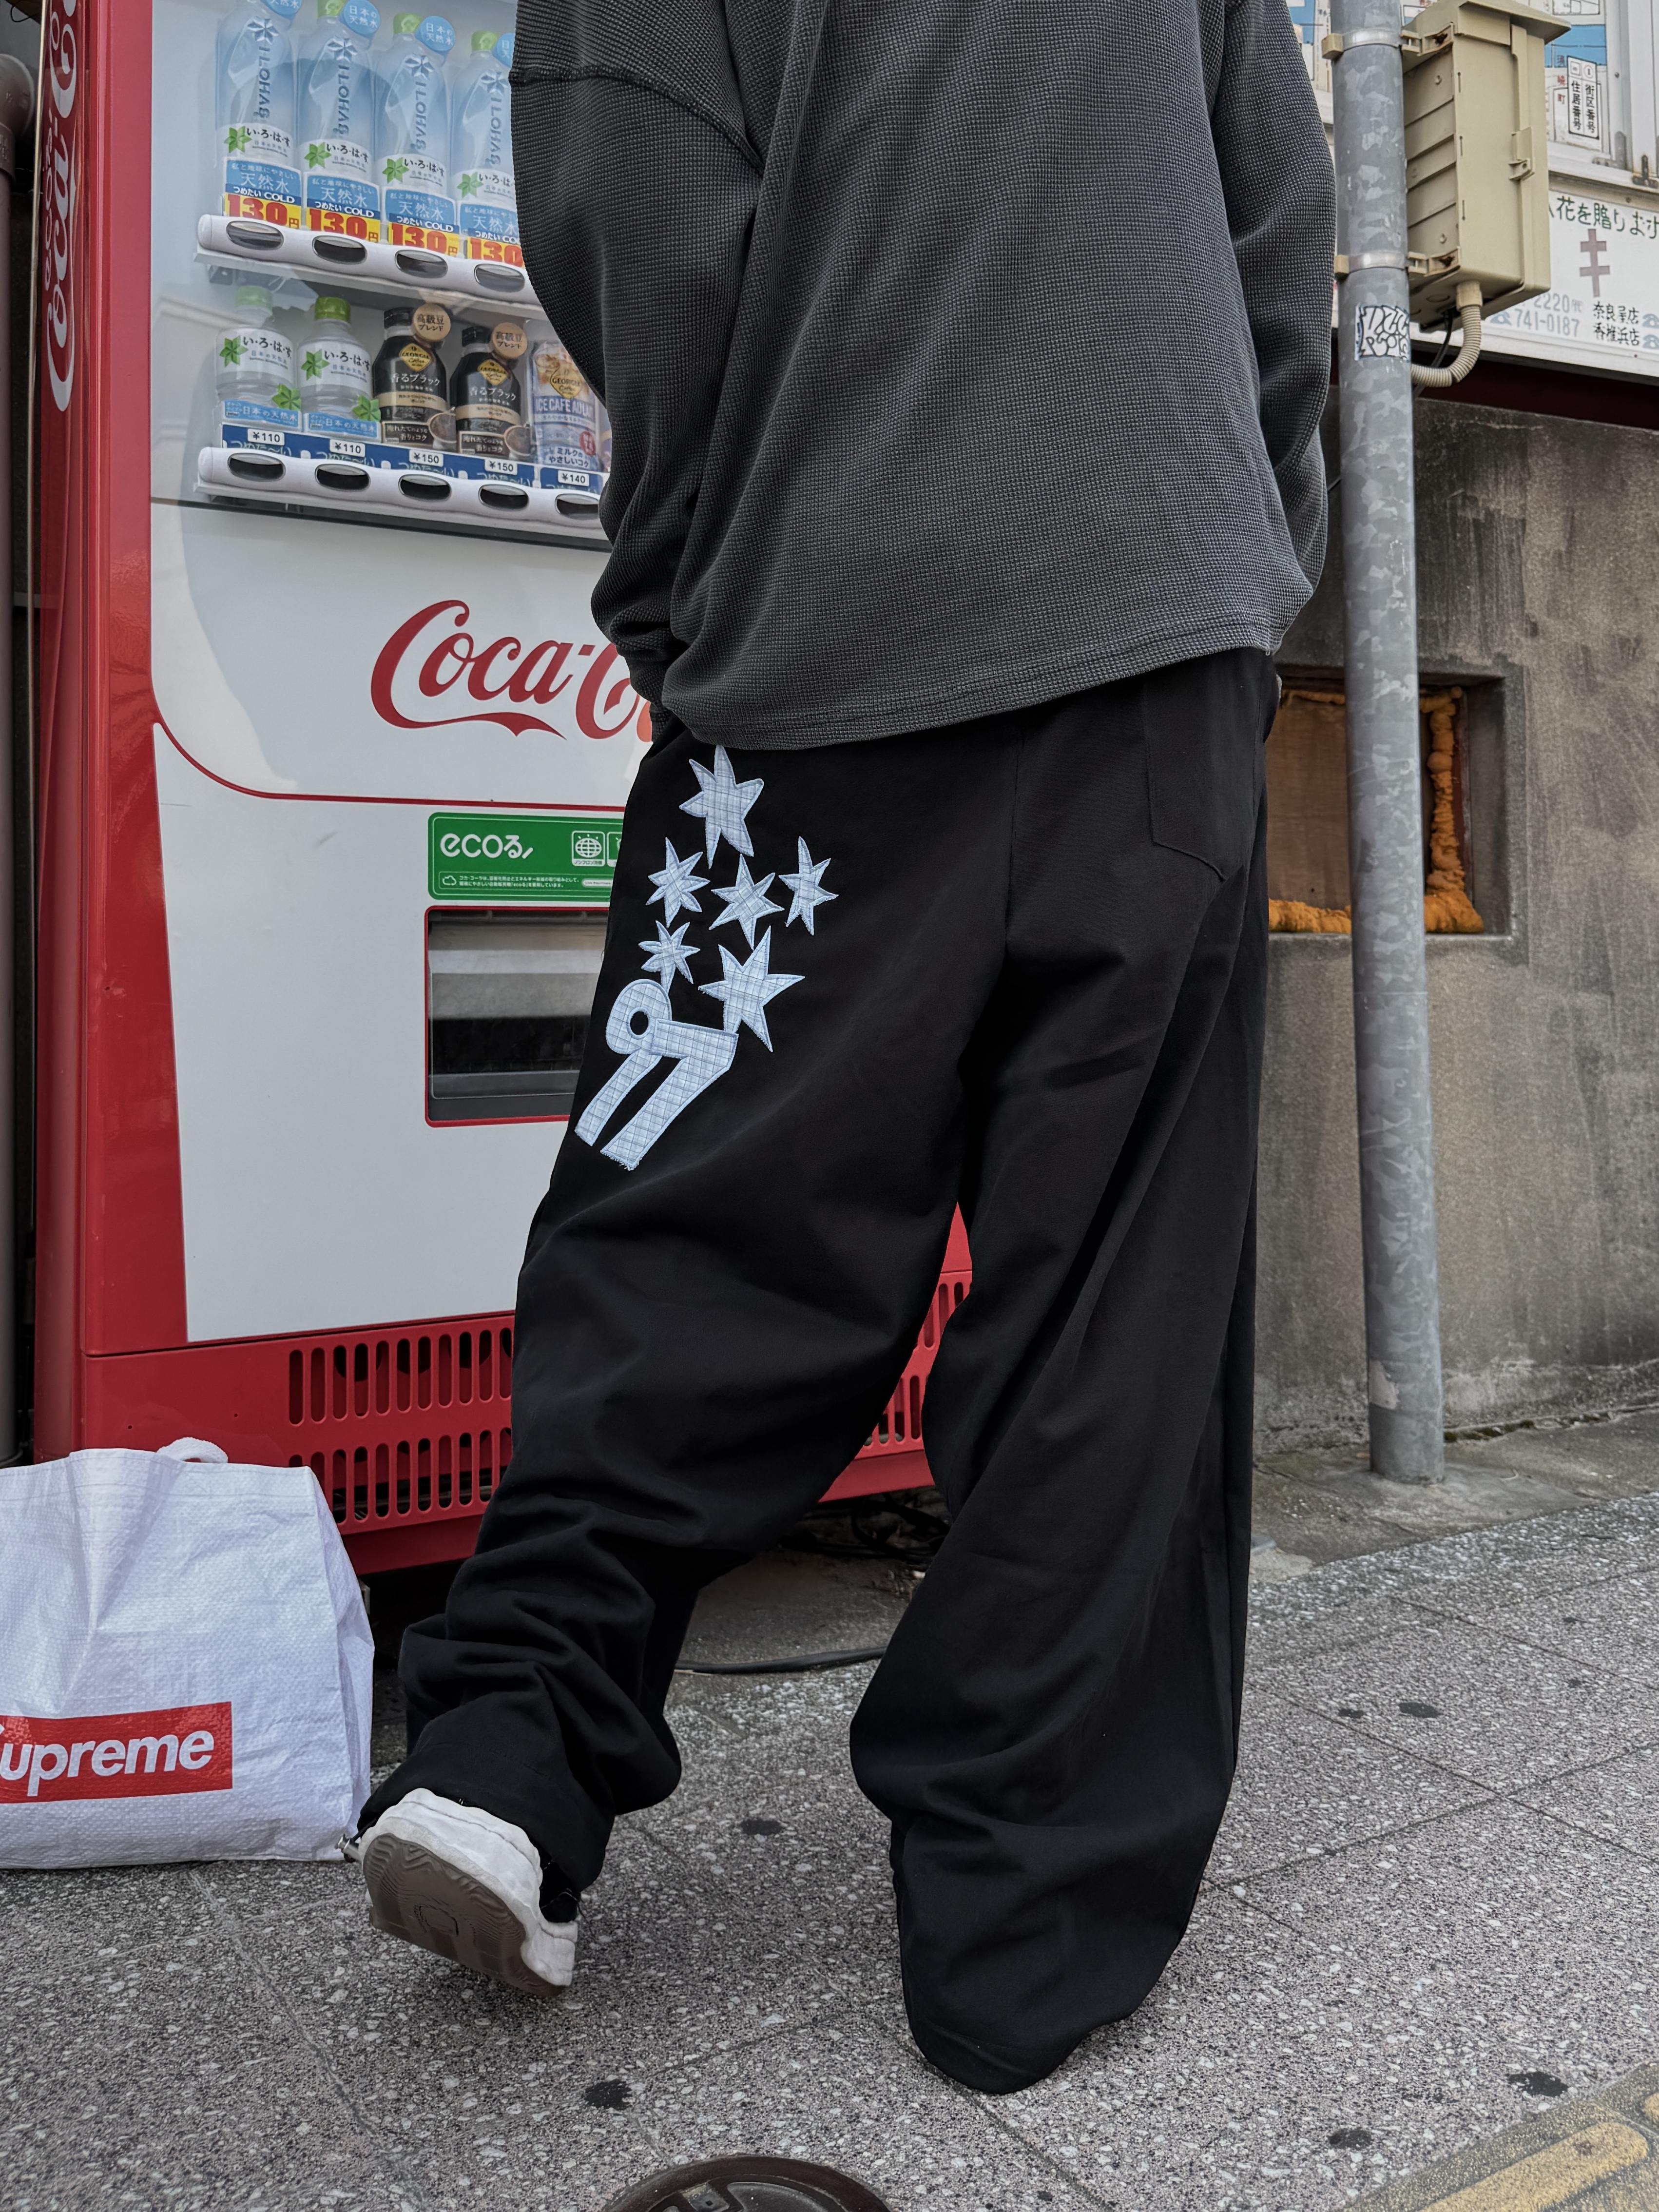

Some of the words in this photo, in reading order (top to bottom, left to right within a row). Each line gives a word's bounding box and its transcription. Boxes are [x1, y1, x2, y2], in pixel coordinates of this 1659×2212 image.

[349, 5, 378, 19] 日本の
[349, 16, 378, 28] 天然水
[426, 23, 453, 36] 日本の
[426, 34, 453, 46] 天然水
[241, 173, 289, 193] 天然水
[233, 186, 261, 197] つめたい
[264, 192, 295, 203] COLD
[321, 187, 367, 208] 天然水
[315, 201, 341, 212] つめたい
[344, 206, 374, 217] COLD
[399, 201, 444, 221] 天然水
[396, 216, 423, 226] つめたい
[425, 221, 454, 232] COLD
[473, 215, 518, 235] 天然水
[475, 231, 500, 241] つめたい
[502, 236, 518, 244] CO
[417, 314, 444, 325] 高級豆
[1593, 301, 1639, 324] 奈良屋店
[1515, 308, 1580, 337] 741-0187
[549, 398, 571, 412] CAFE
[253, 431, 280, 443] ¥110
[335, 442, 361, 454] ¥110
[557, 447, 583, 458] ミルクの
[413, 453, 439, 464] ¥150
[549, 456, 589, 467] やさしいコク
[489, 462, 514, 472] ¥150
[562, 473, 586, 484] ¥140
[370, 600, 652, 743] Coca-C
[574, 978, 739, 1171] 97
[0, 1723, 214, 1797] upreme
